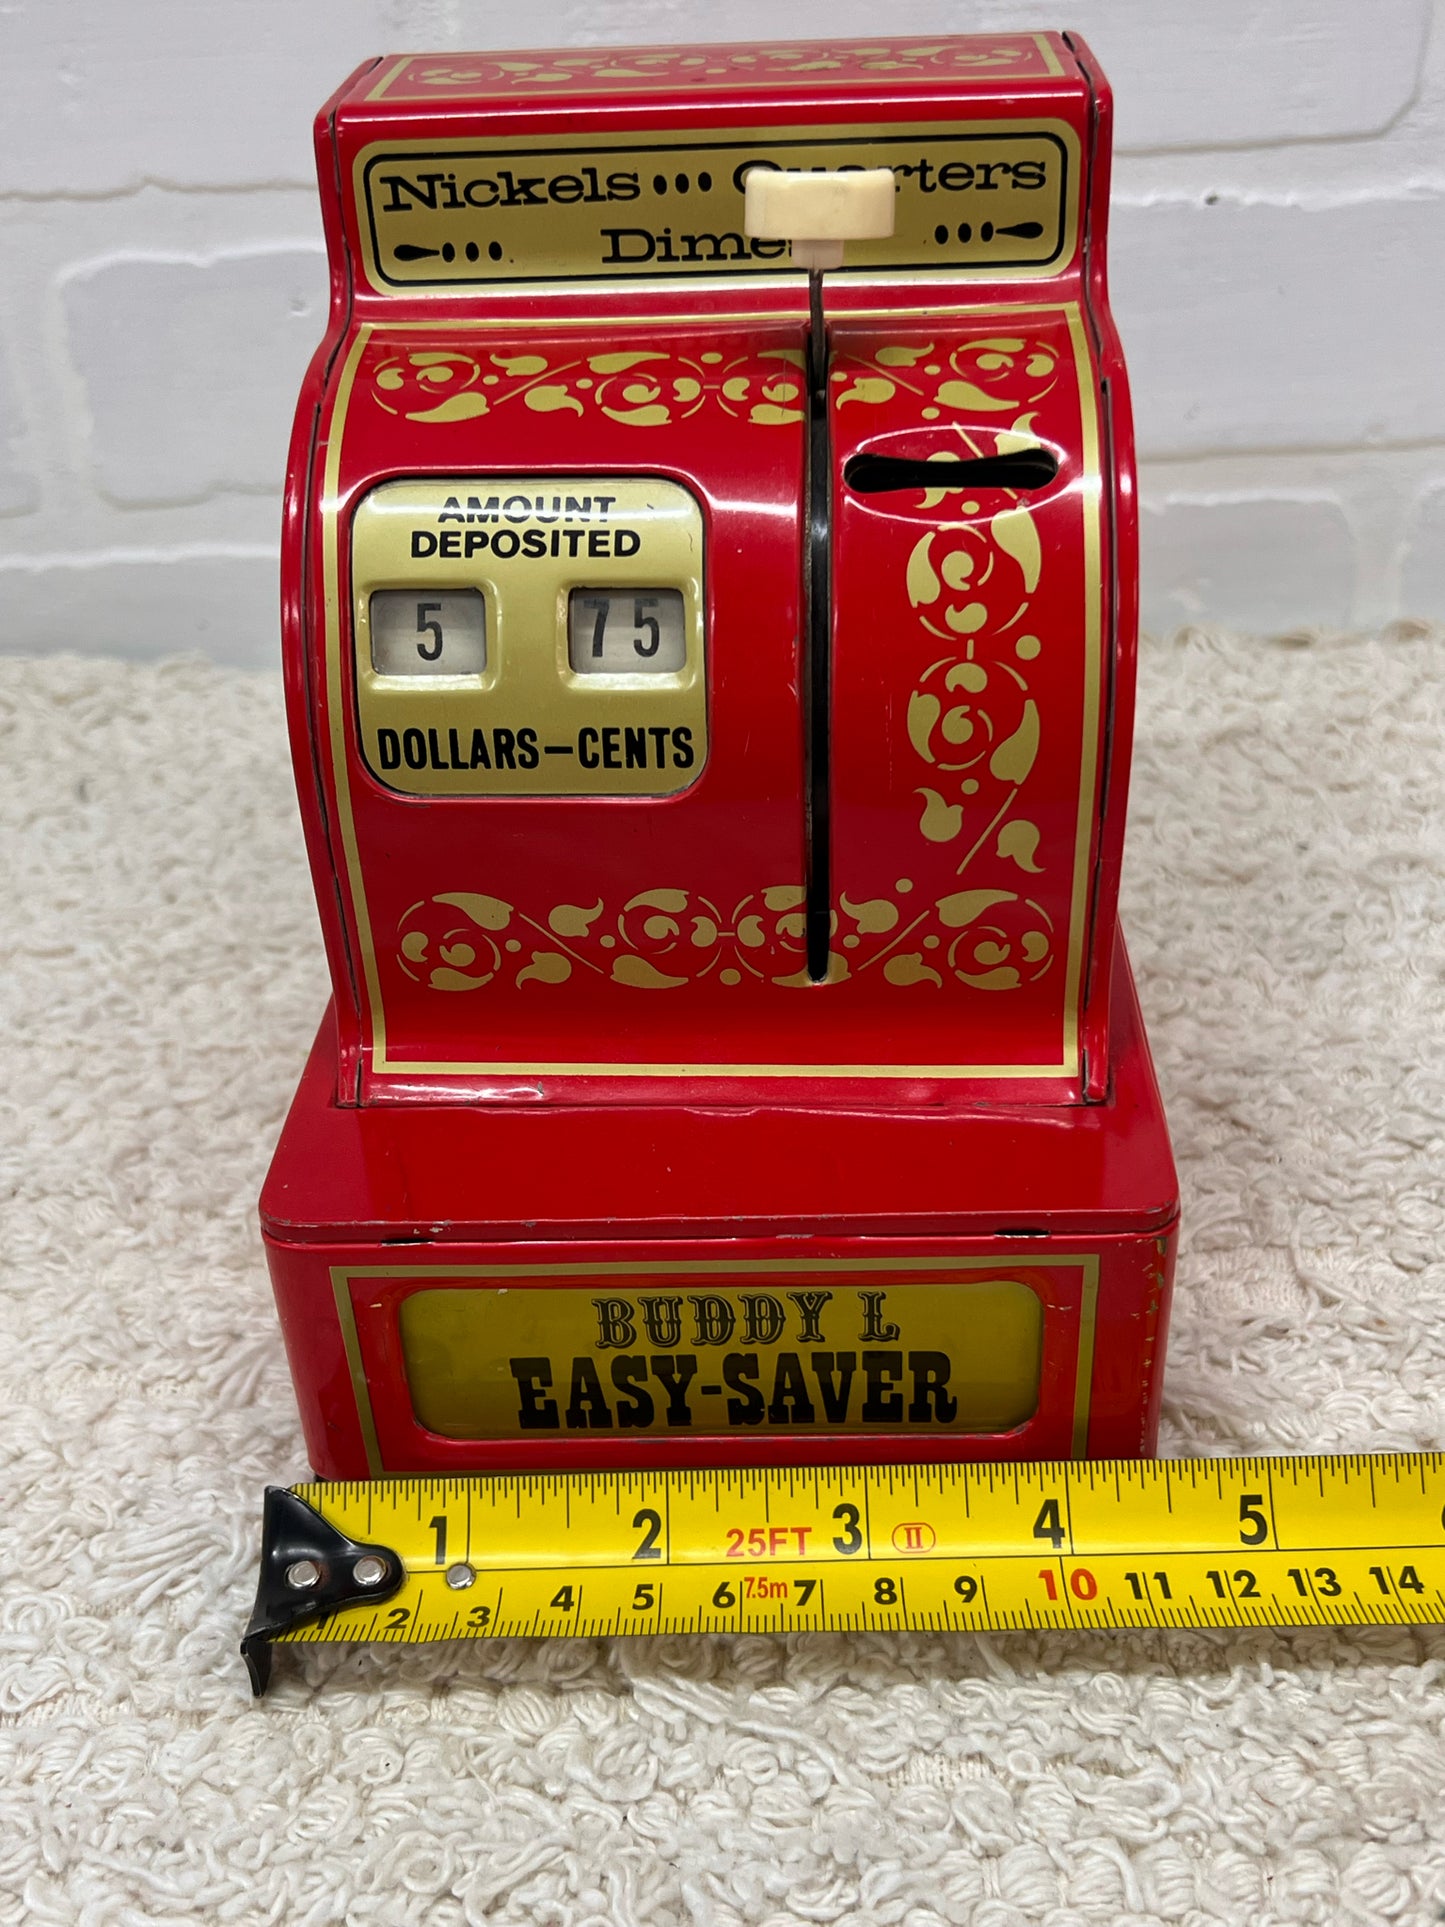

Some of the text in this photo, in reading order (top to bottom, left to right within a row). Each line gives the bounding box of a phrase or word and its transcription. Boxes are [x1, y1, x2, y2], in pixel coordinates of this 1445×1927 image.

[379, 158, 1047, 213] Nickels rters
[600, 225, 793, 265] Dime
[437, 495, 617, 524] AMOUNT
[410, 529, 642, 559] DEPOSITED
[416, 602, 444, 661] 5
[591, 1290, 900, 1349] BUDDY L
[509, 1349, 958, 1430] EASY-SAVER
[428, 1508, 662, 1566] 1 2
[725, 1526, 812, 1558] 25FT
[831, 1502, 863, 1555] 3
[1033, 1494, 1268, 1549] 4 5
[383, 1607, 411, 1630] 2
[466, 1605, 491, 1629] 3
[550, 1585, 575, 1612] 4
[631, 1583, 656, 1611] 5
[711, 1581, 736, 1609] 6
[743, 1575, 789, 1599] 7.5m
[793, 1565, 1424, 1607] 7 8 9 10 11 12 13 14
